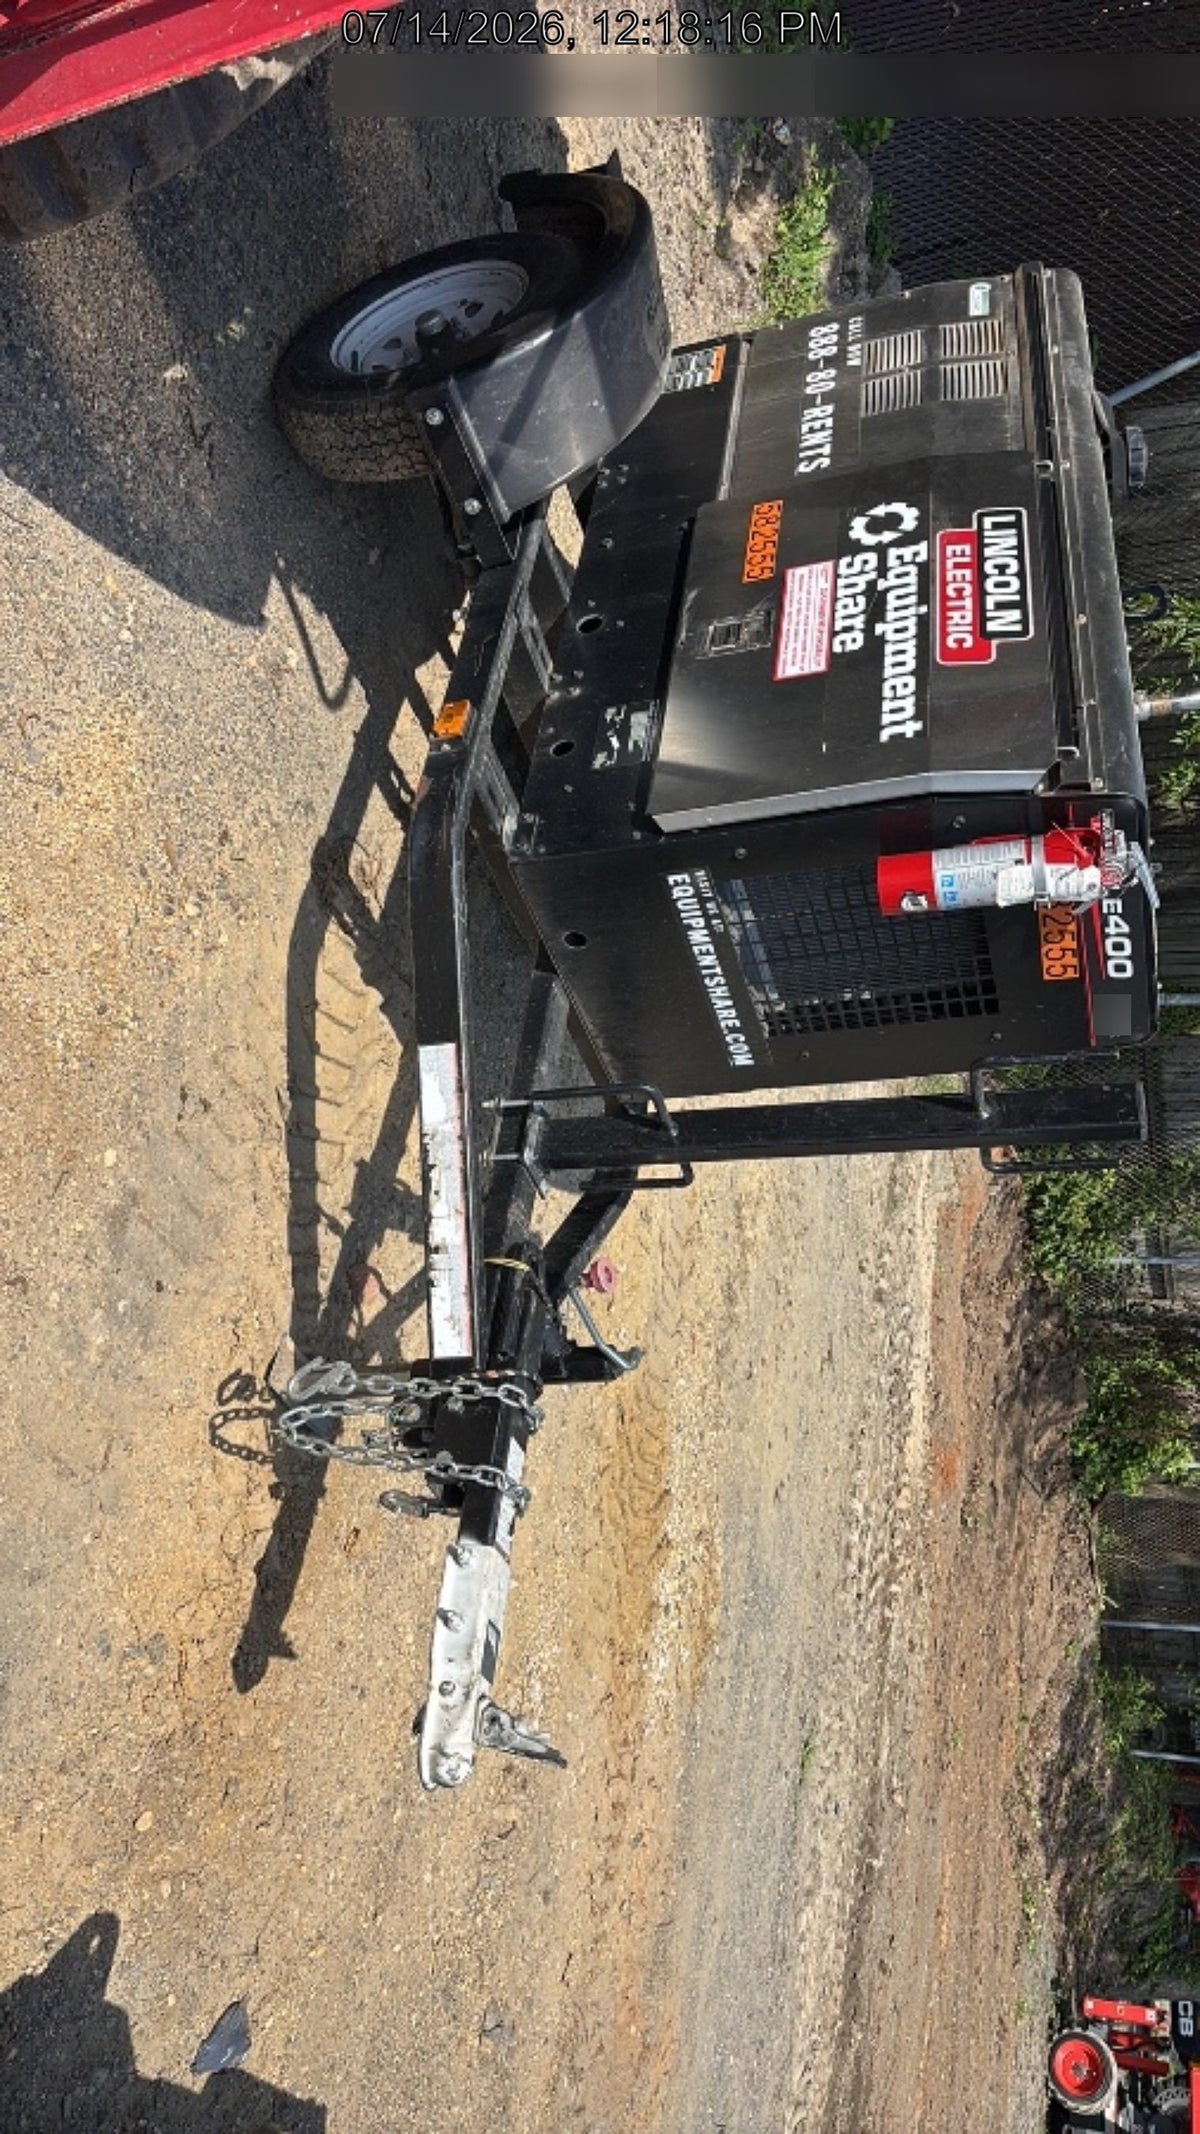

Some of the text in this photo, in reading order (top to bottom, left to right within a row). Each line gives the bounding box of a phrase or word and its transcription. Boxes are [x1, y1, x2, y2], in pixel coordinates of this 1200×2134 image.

[798, 322, 840, 473] 888-80-RENTS
[746, 502, 782, 580] 582555
[983, 514, 1022, 632] LINCOLN
[832, 552, 878, 653] Share
[874, 540, 928, 743] Equipment
[946, 544, 973, 649] ELECTRIC
[666, 873, 755, 1067] EQUIPMENTSHARE.COM
[1043, 901, 1078, 978] 2555
[1102, 898, 1134, 979] E400
[1178, 2001, 1194, 2037] CB
